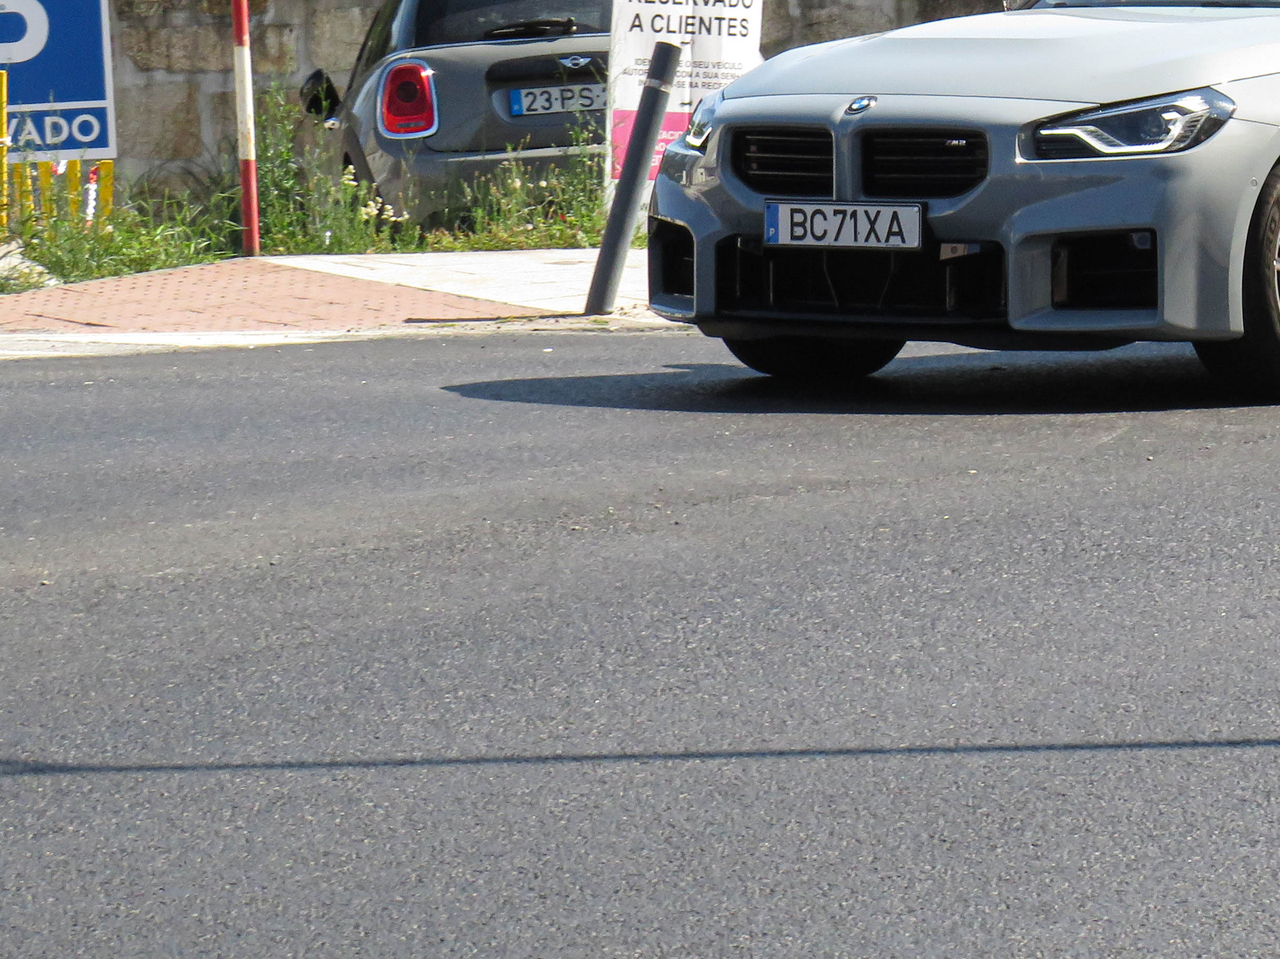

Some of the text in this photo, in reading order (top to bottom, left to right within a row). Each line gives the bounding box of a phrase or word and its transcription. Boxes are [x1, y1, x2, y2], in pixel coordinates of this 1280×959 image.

[628, 13, 749, 37] A CLIENTES
[692, 60, 709, 69] SEU
[703, 71, 719, 79] SUA
